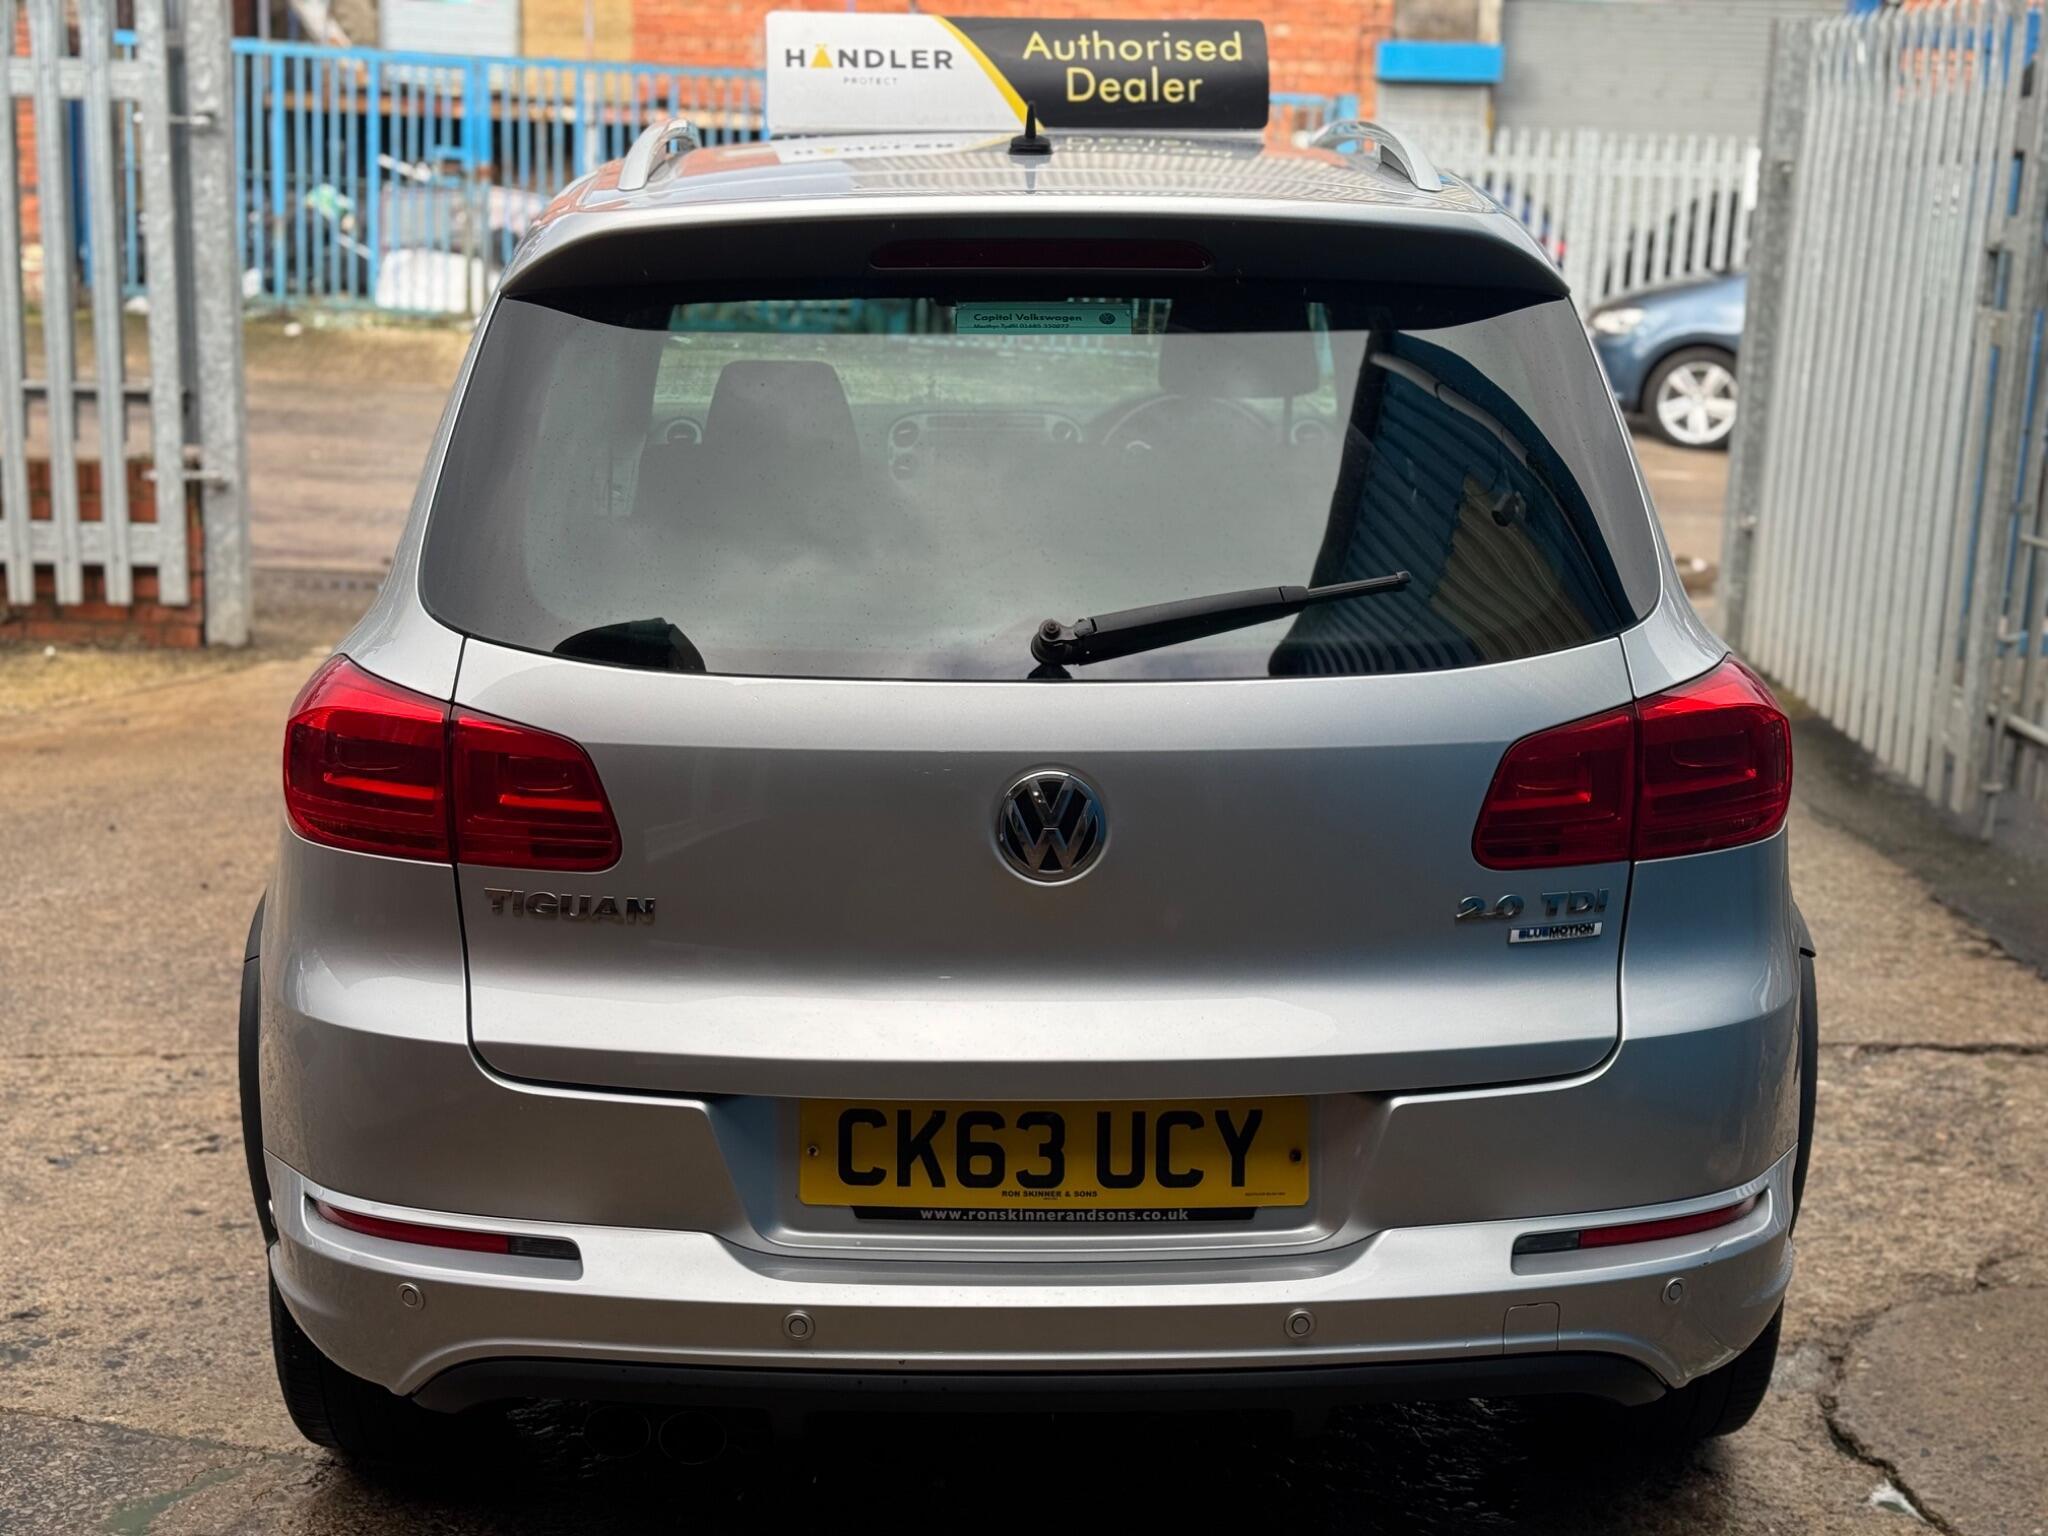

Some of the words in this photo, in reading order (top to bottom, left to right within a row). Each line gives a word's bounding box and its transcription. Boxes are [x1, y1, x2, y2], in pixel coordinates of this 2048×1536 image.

[1021, 30, 1243, 62] Authorised
[843, 76, 898, 86] PROTECT
[1066, 66, 1204, 103] Dealer
[1015, 313, 1083, 323] Volkswagen
[484, 887, 656, 926] TIGUAN
[1454, 894, 1525, 922] 2.0
[1541, 887, 1609, 917] TDI
[837, 1108, 1066, 1189] CK63
[1096, 1109, 1263, 1189] UCY
[1001, 1190, 1020, 1198] RON
[1023, 1190, 1062, 1198] SKINNER
[1065, 1190, 1071, 1198] &
[1074, 1190, 1098, 1198] SONS
[920, 1207, 1189, 1222] www.ronskinnerandsons.co.uk
